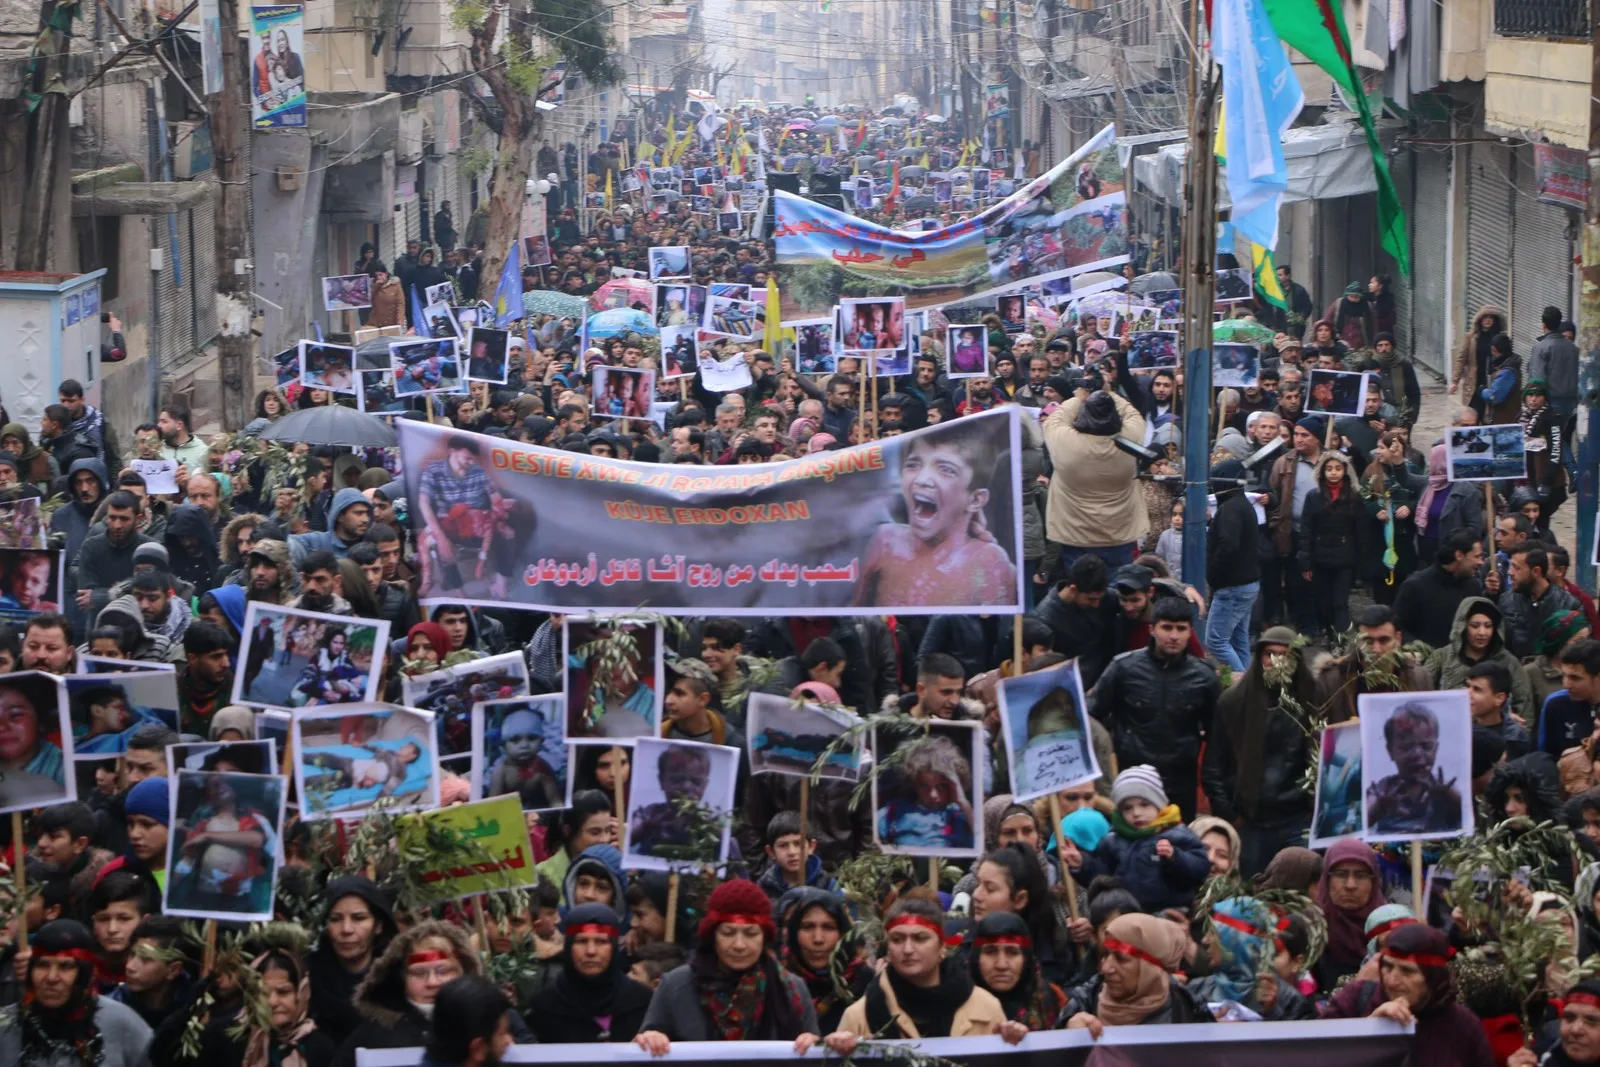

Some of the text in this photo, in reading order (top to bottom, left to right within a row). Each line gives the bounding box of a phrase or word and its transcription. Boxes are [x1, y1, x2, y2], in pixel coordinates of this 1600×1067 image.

[832, 246, 926, 269] في حلب
[670, 471, 775, 493] ROJAVA
[671, 499, 811, 526] ERDOXAN
[523, 551, 598, 587] أردوغان
[600, 558, 643, 587] قاتل
[724, 563, 756, 588] من
[759, 558, 799, 588] يدك
[801, 557, 860, 588] اسحب
